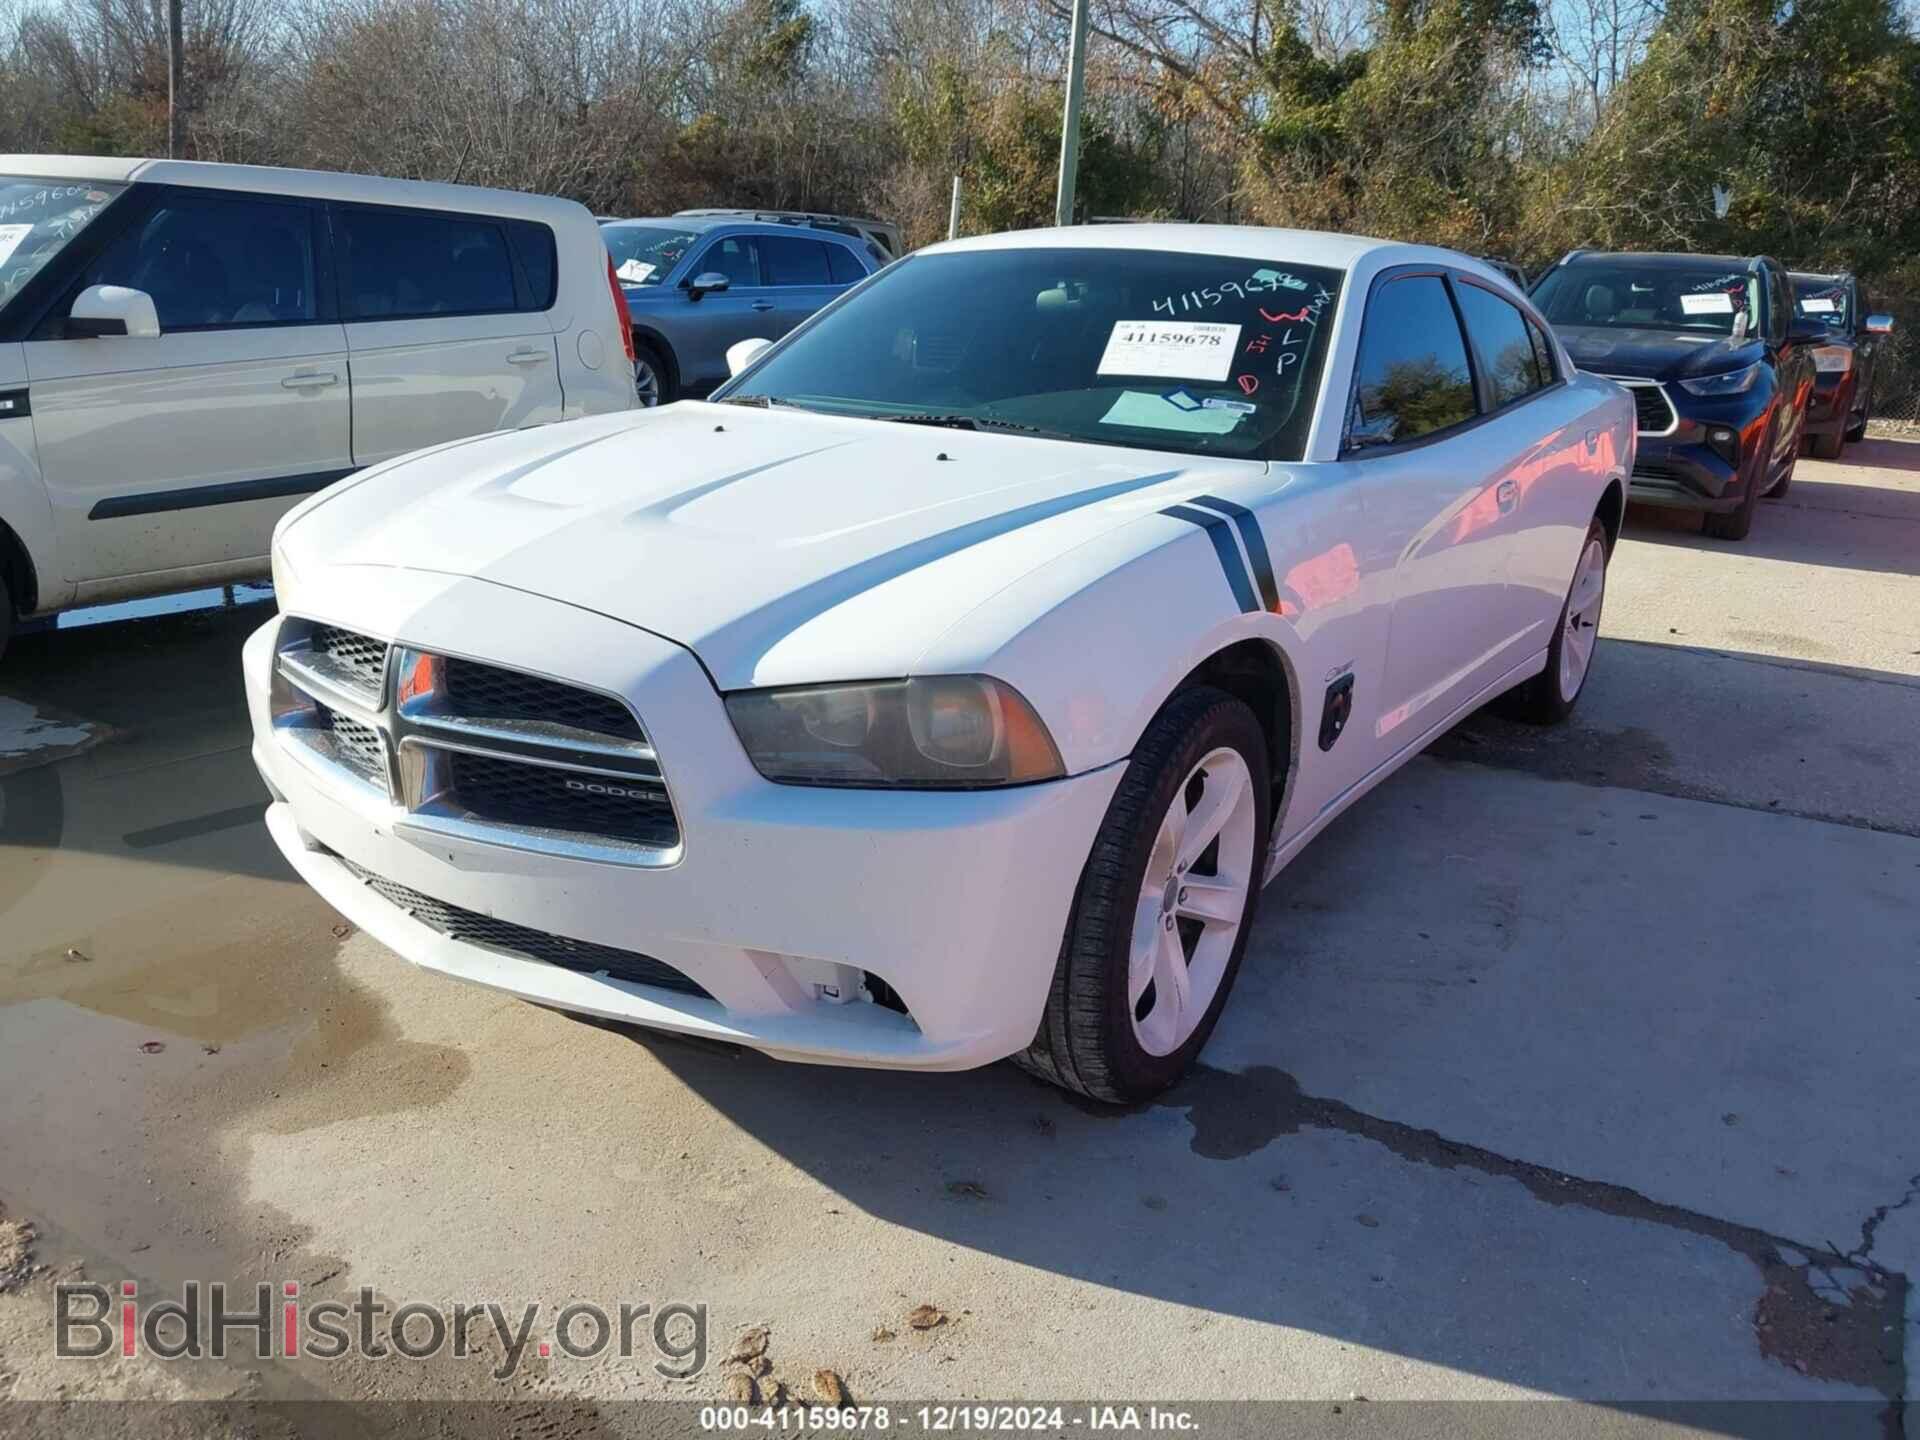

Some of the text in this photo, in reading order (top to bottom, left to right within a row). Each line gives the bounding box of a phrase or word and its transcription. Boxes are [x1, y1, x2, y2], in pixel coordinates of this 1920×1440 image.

[1121, 331, 1222, 346] 41159678
[1282, 328, 1303, 346] L
[1276, 352, 1297, 375] P
[565, 780, 666, 800] DODGE
